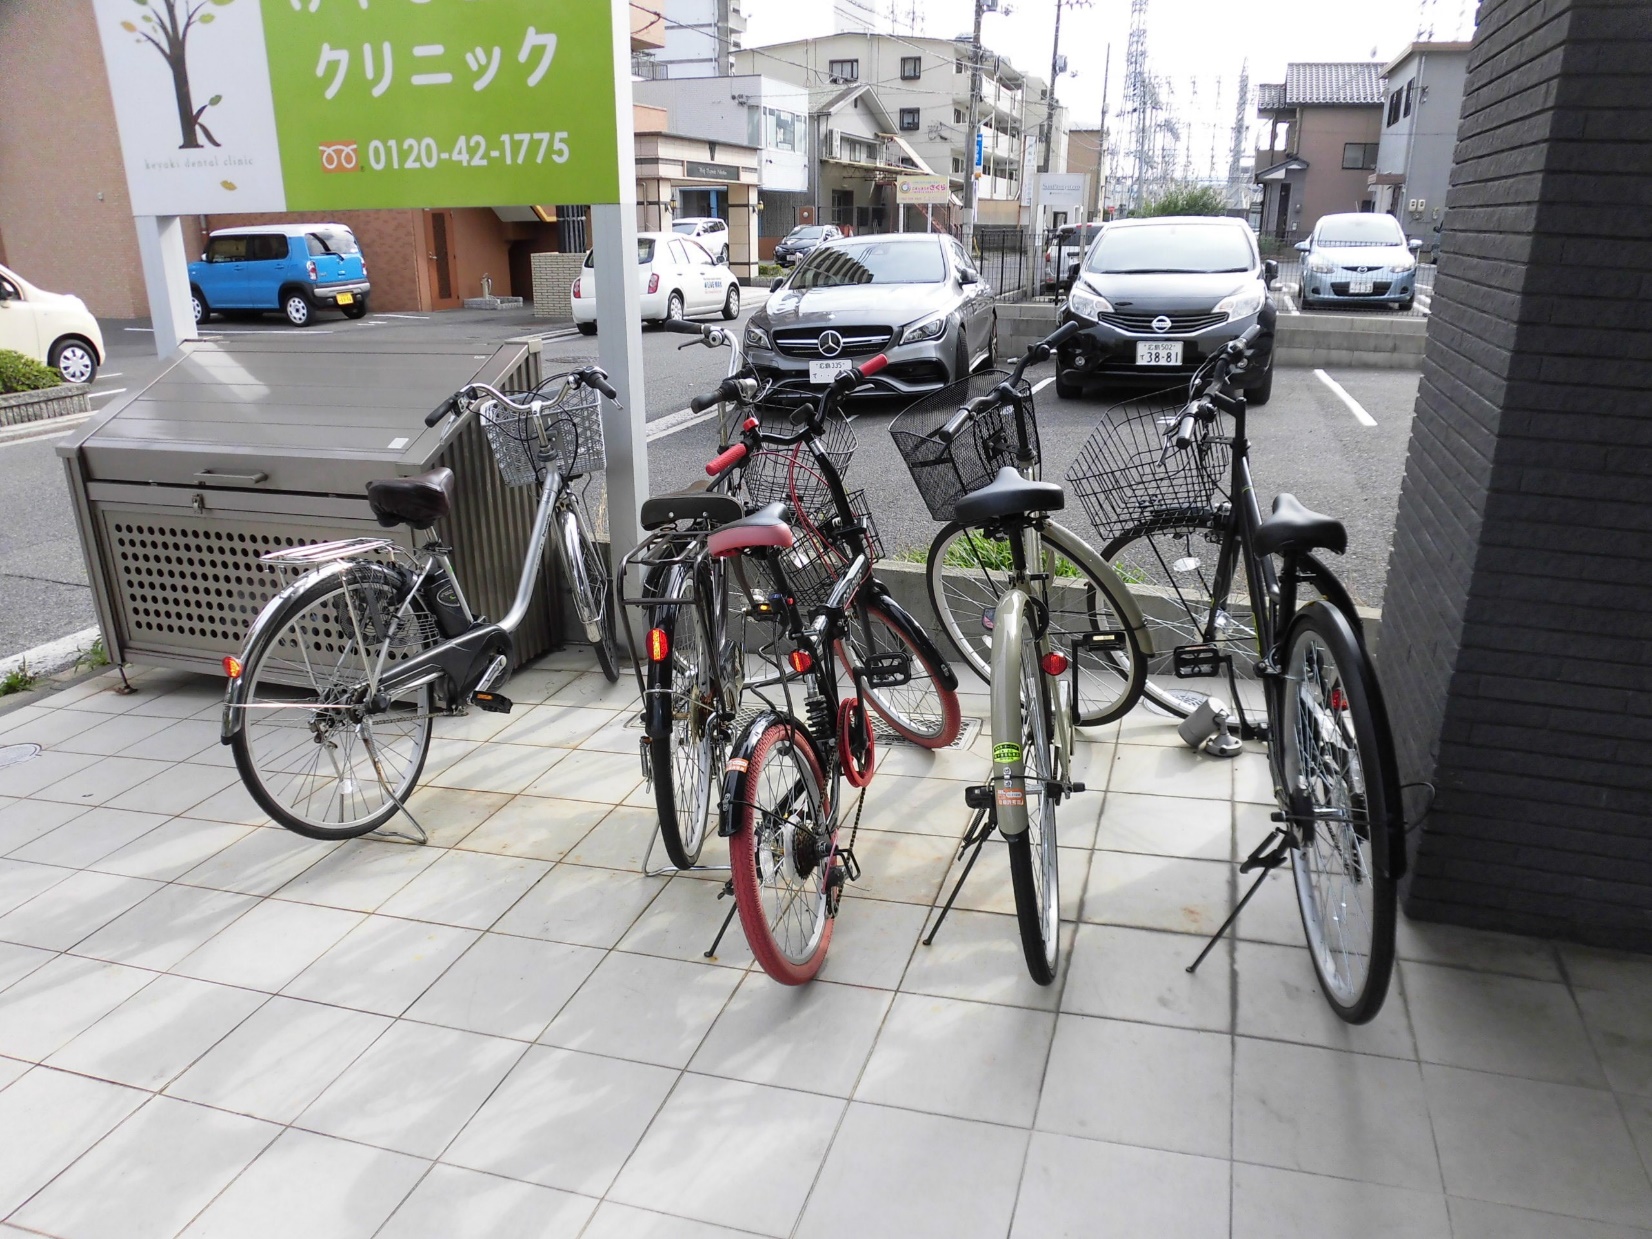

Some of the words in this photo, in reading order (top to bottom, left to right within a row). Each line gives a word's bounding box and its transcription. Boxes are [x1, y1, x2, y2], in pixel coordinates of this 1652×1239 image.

[316, 26, 557, 100] クリニック
[184, 156, 219, 168] dental
[223, 154, 254, 166] clinic
[368, 131, 570, 170] 0120-42-1775
[1146, 351, 1179, 363] 38-81
